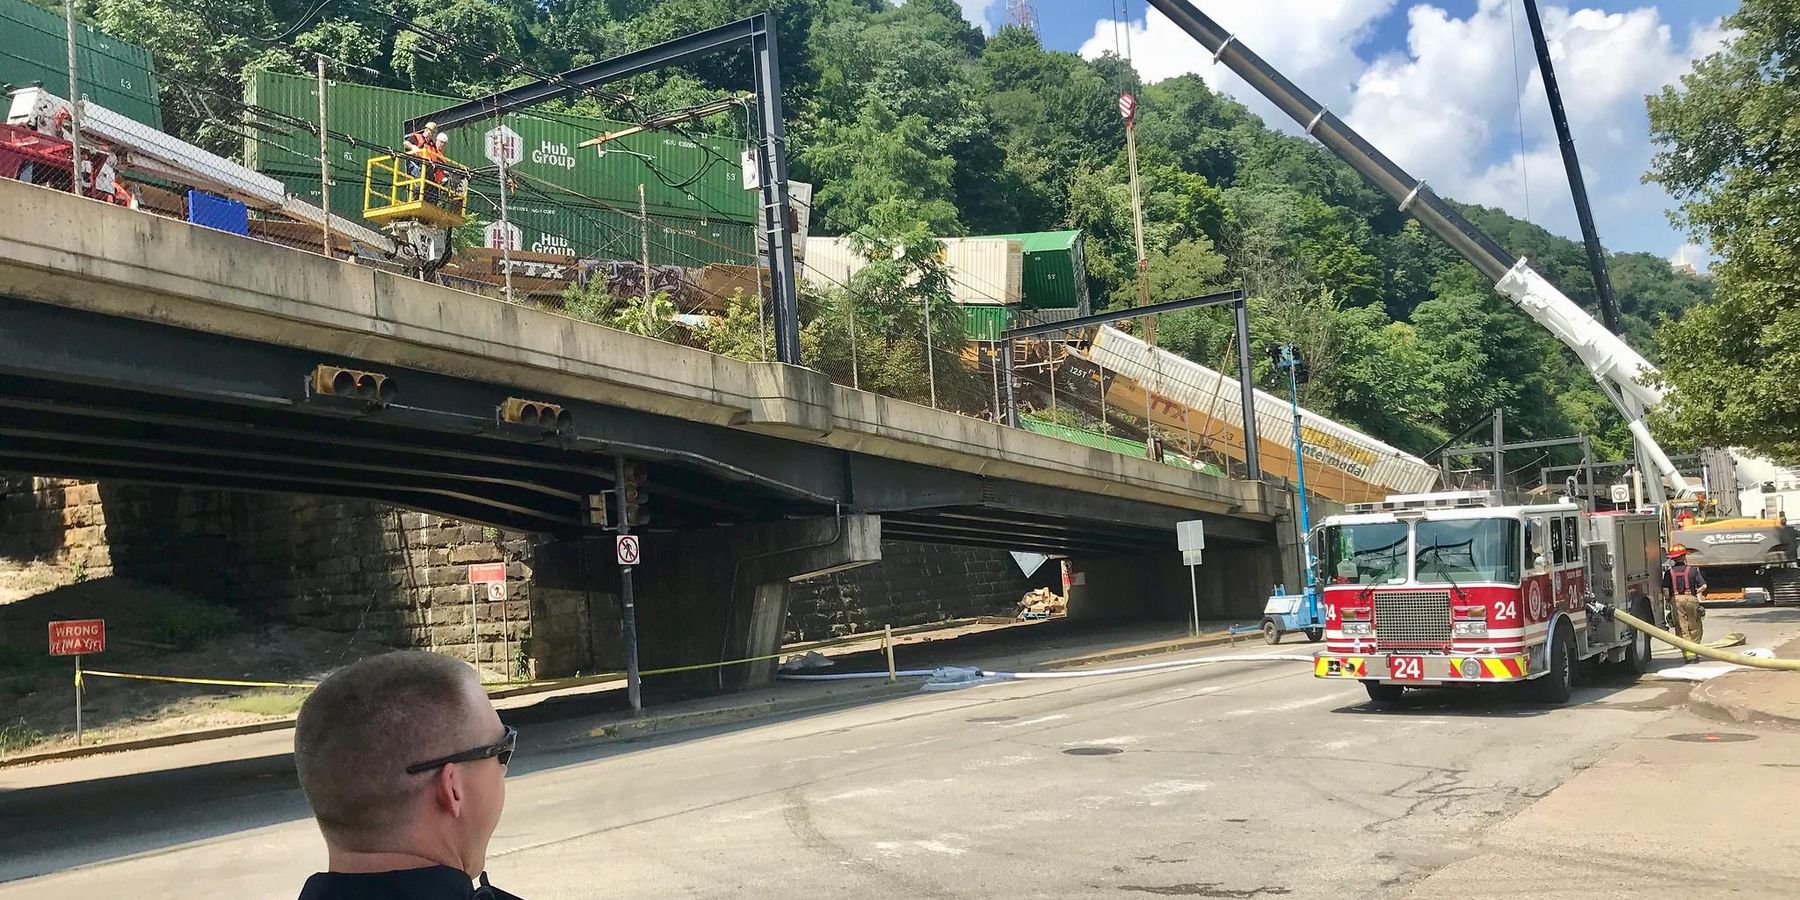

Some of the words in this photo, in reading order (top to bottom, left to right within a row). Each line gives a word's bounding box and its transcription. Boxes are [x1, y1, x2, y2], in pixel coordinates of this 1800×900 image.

[541, 140, 568, 156] Hub
[531, 149, 576, 170] Group
[726, 172, 736, 181] 53
[541, 232, 569, 248] Hub
[498, 259, 568, 279] TTX
[1150, 394, 1190, 423] TTX
[1300, 443, 1367, 479] ntermodal
[1568, 584, 1579, 609] 24
[1494, 601, 1517, 620] 24
[55, 625, 99, 637] WRONG
[65, 638, 90, 650] WAY
[1394, 658, 1421, 678] 24
